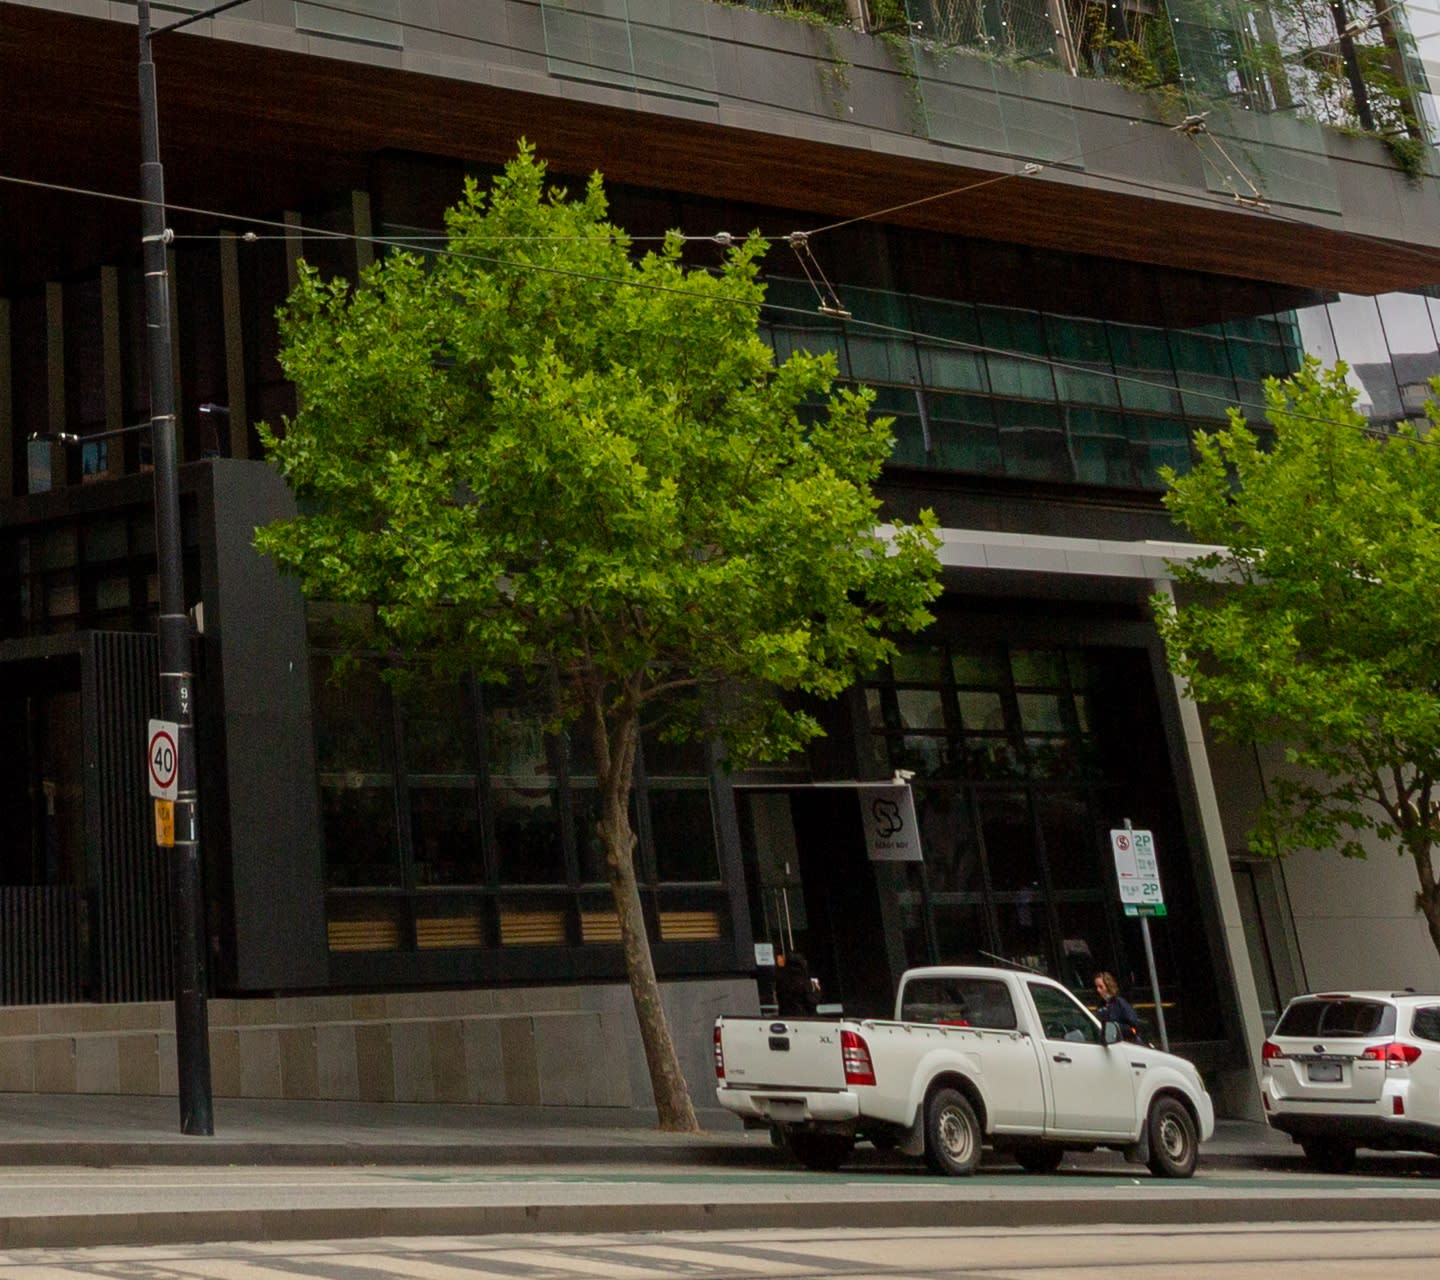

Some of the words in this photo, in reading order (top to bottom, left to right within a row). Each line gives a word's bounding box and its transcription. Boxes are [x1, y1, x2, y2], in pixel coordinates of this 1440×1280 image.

[154, 746, 172, 773] 40
[1135, 835, 1150, 847] 2P
[1142, 883, 1159, 895] 2P
[820, 1035, 833, 1045] XL
